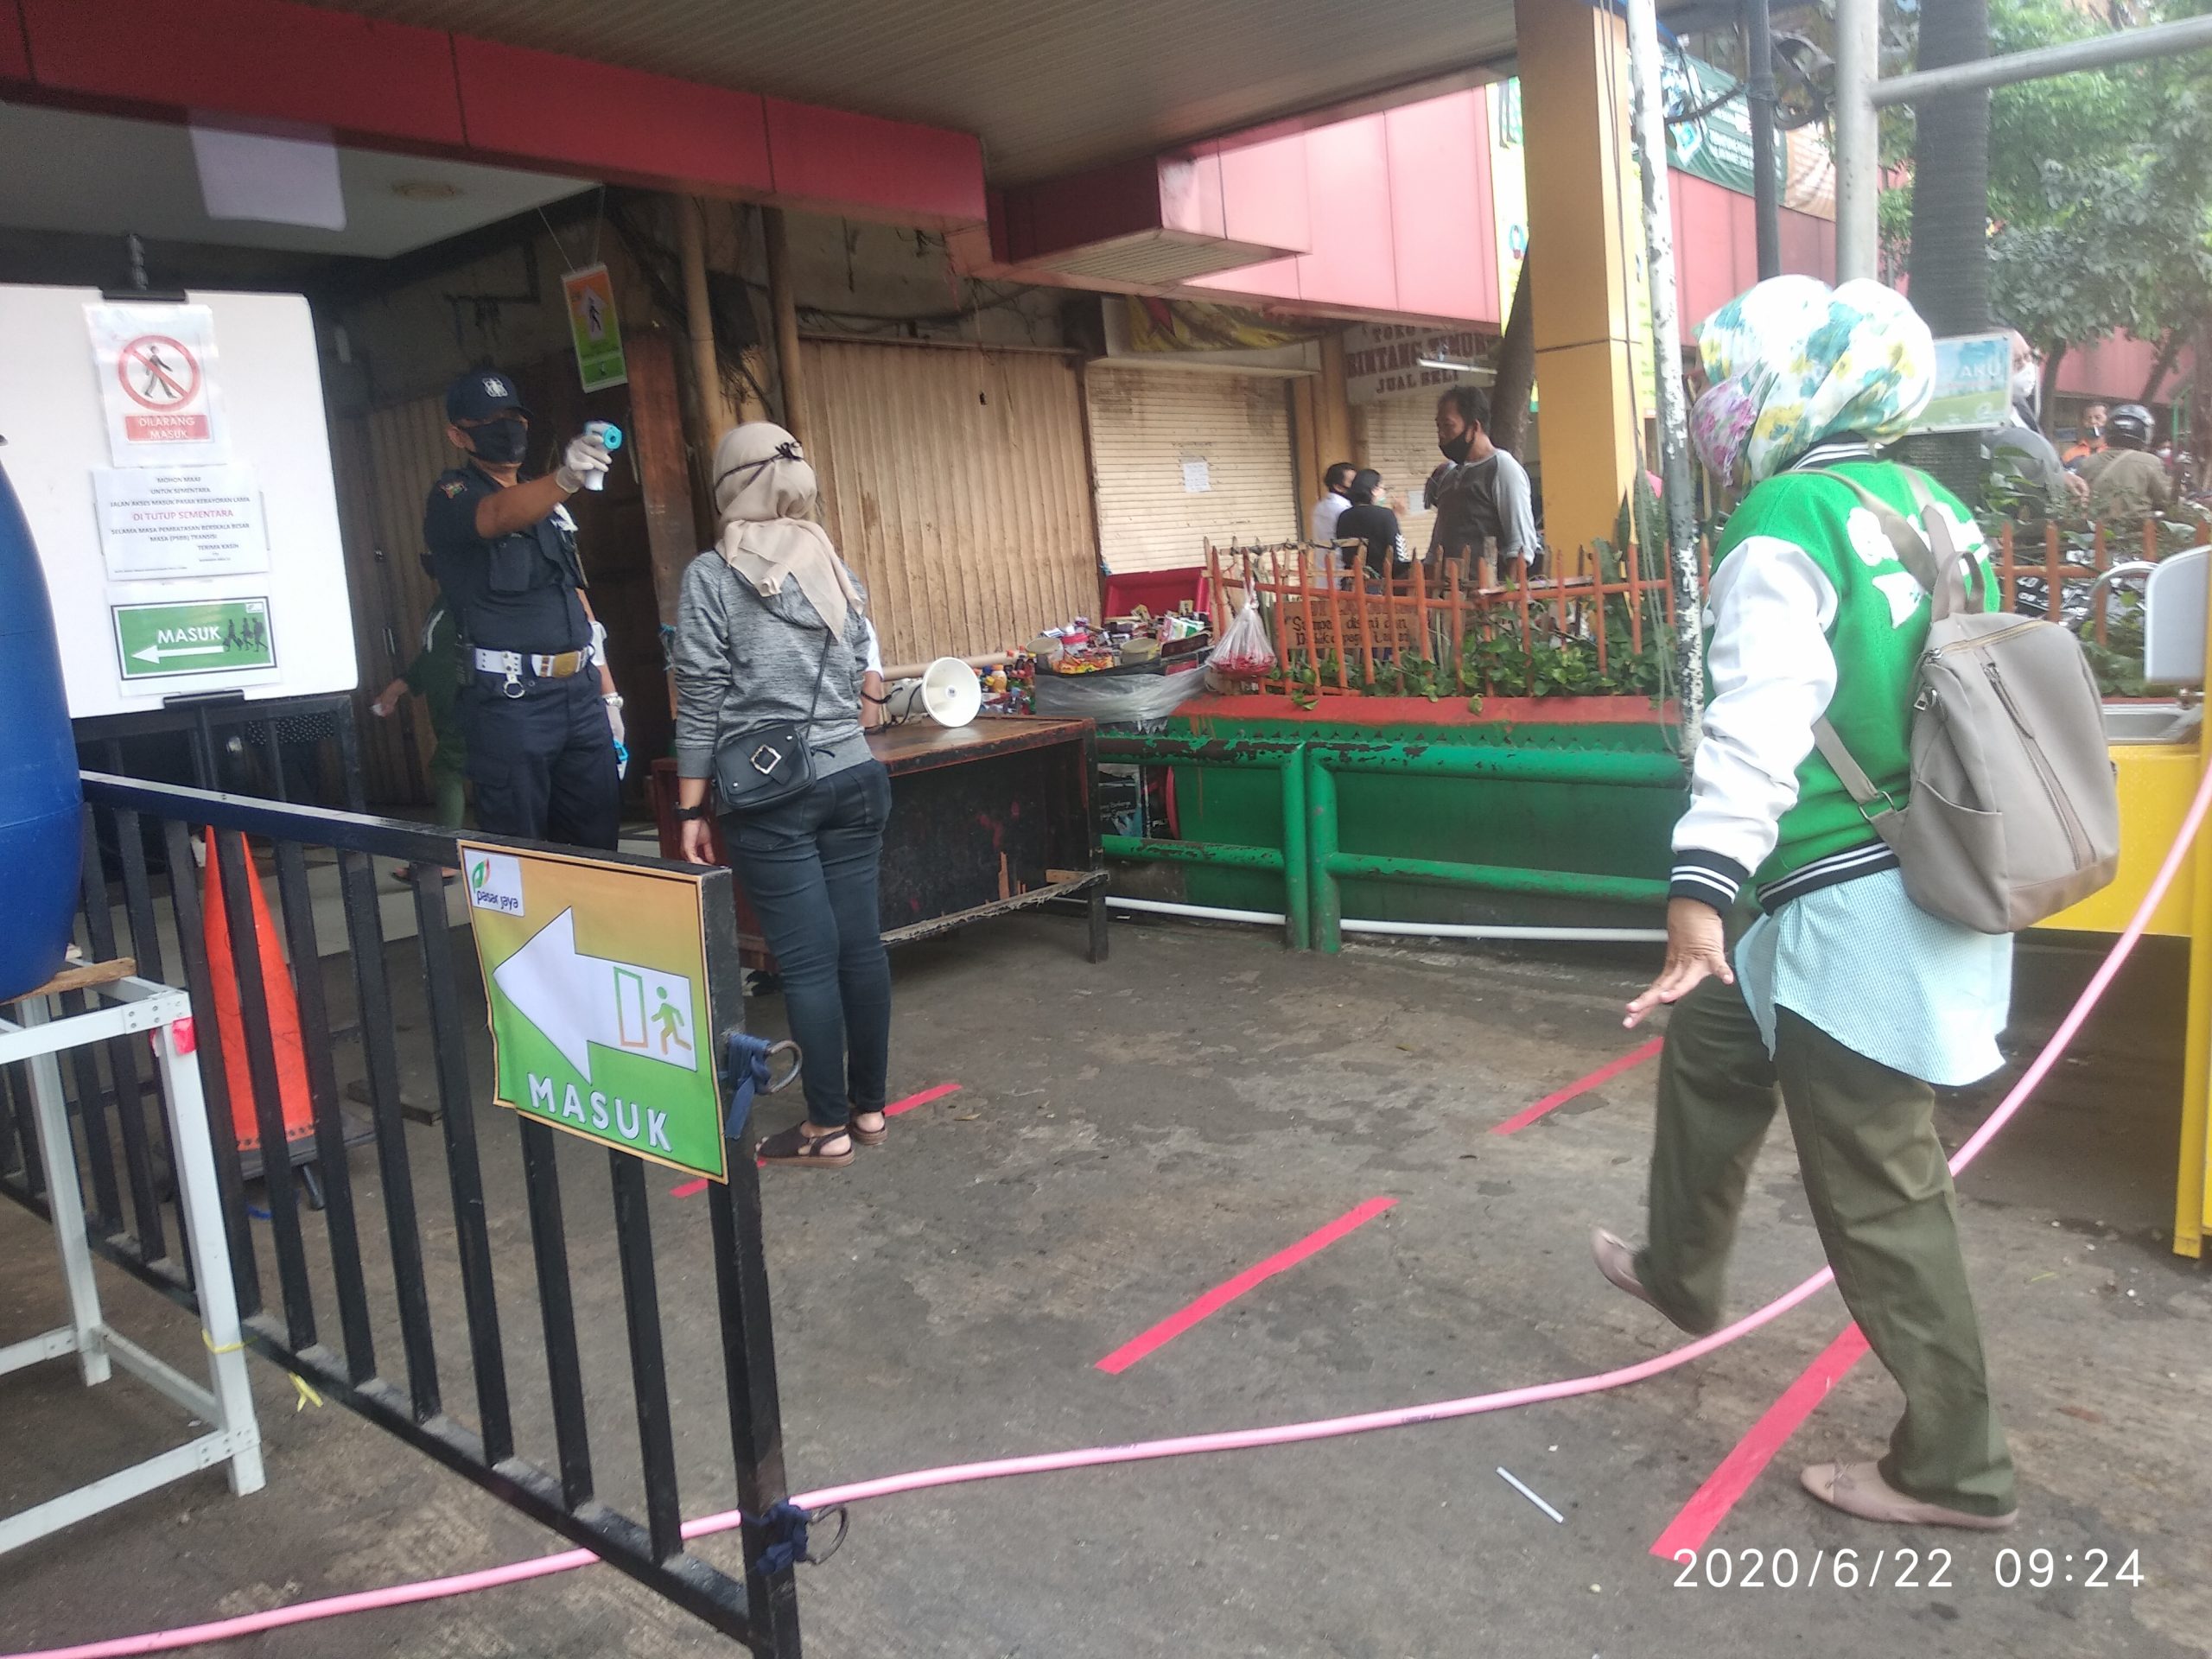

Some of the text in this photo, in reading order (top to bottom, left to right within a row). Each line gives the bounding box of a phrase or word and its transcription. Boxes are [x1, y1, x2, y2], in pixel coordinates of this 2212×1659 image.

[1376, 374, 1416, 394] JUAL
[138, 416, 195, 427] DILARANG
[149, 429, 188, 440] MASUK
[133, 510, 234, 521] DI TUTUP SEMENTARA
[157, 626, 222, 645] MASUK
[477, 890, 518, 911] pasar jaya
[526, 1071, 673, 1153] MASUK
